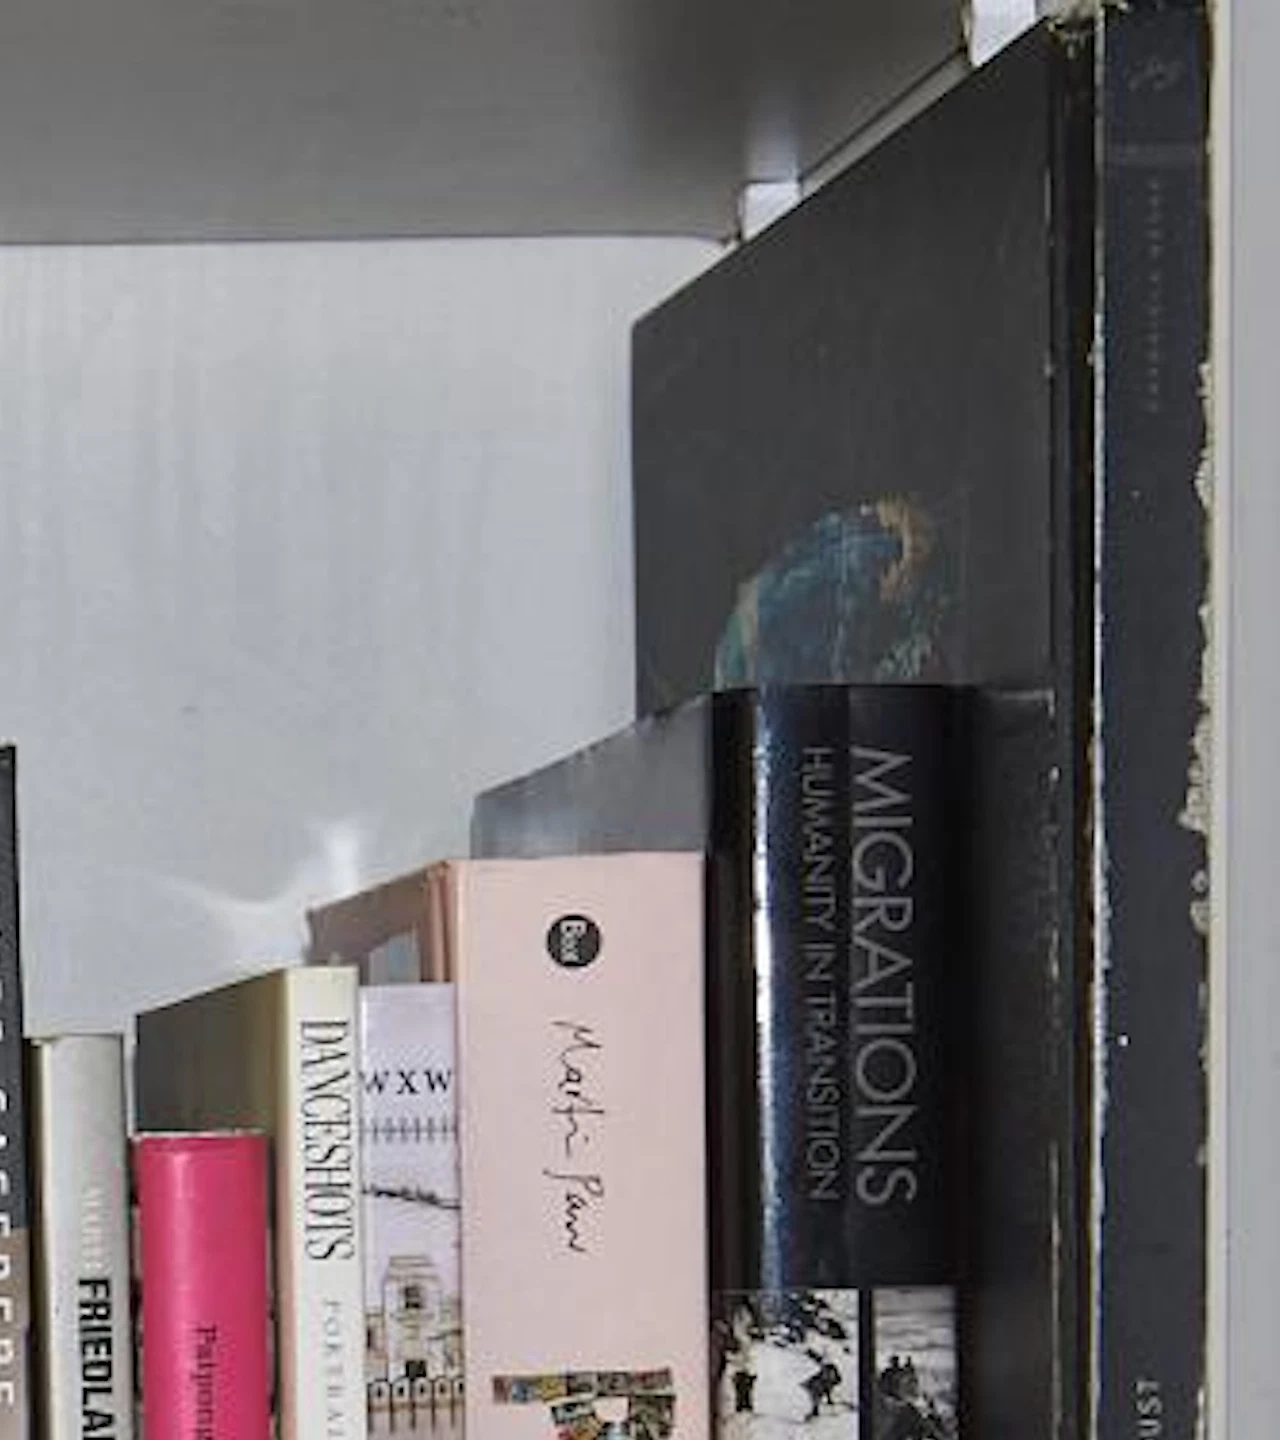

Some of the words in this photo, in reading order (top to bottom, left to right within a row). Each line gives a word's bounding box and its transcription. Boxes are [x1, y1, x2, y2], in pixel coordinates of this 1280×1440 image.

[802, 746, 838, 931] HUMANITY
[805, 941, 838, 982] IN
[848, 746, 918, 1204] MIGRATIONS
[300, 1018, 356, 1262] DANCESHOTS
[803, 990, 843, 1199] TRANSITION
